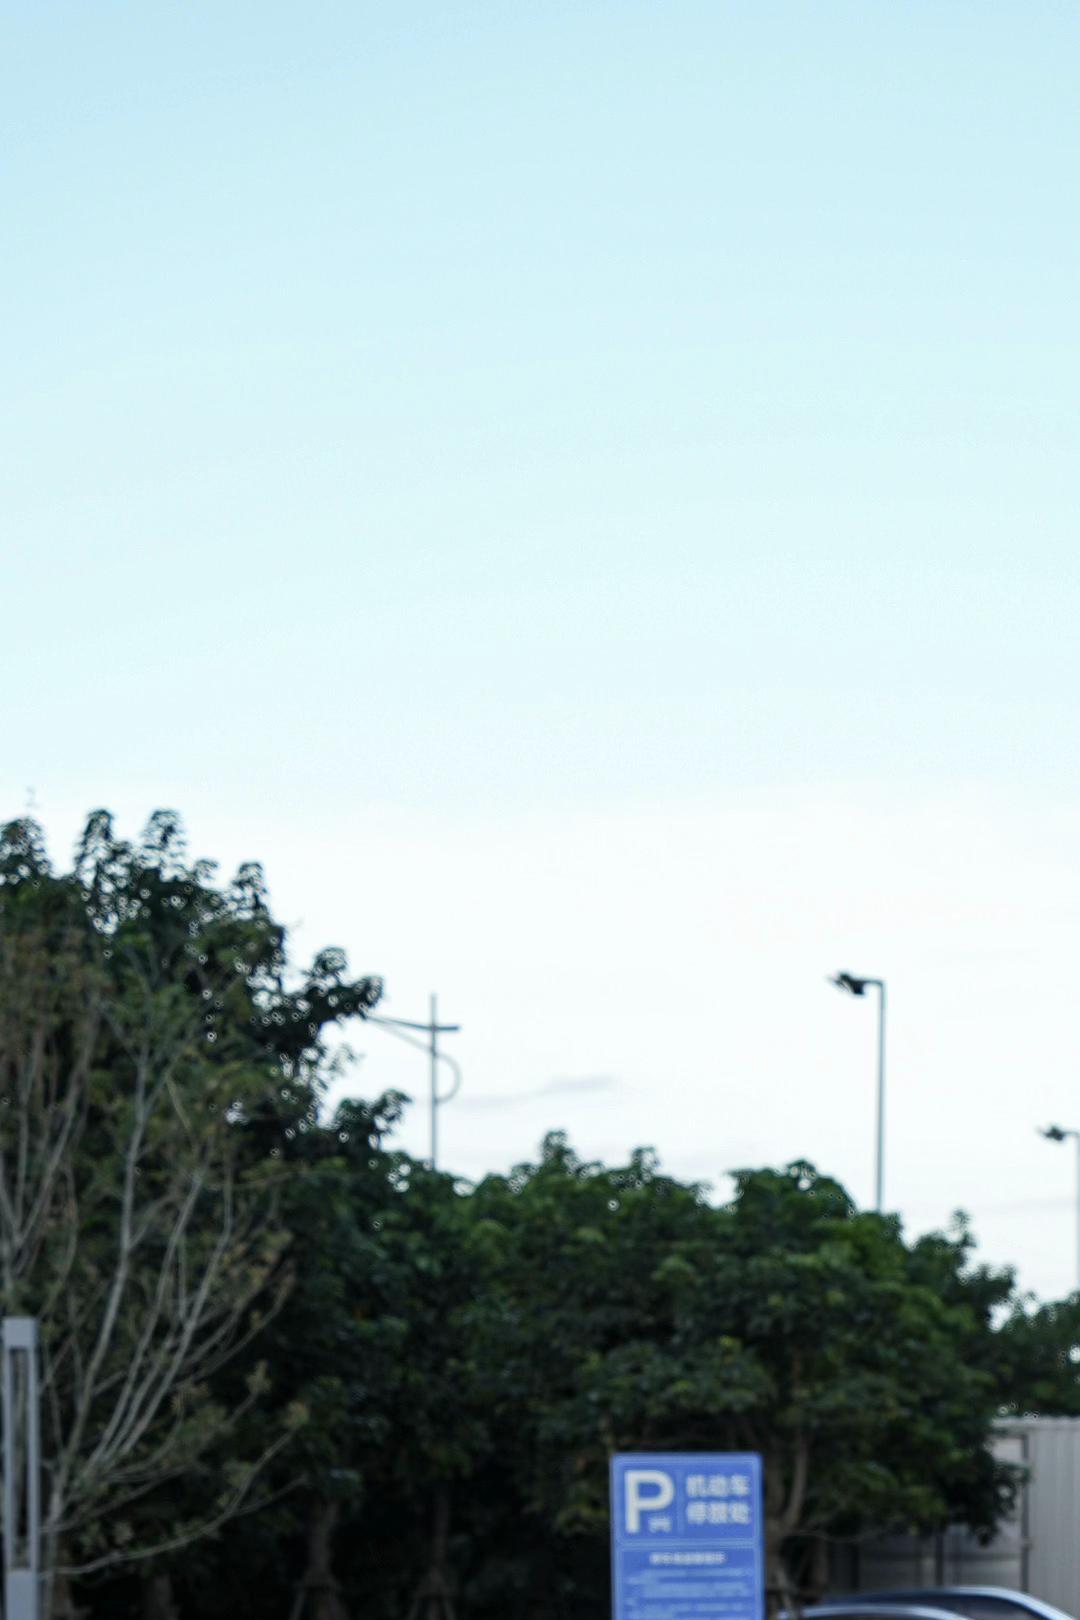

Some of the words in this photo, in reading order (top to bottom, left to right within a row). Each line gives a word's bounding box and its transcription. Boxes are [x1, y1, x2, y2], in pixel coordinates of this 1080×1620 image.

[624, 1469, 675, 1534] P
[686, 1474, 750, 1497] 机动车
